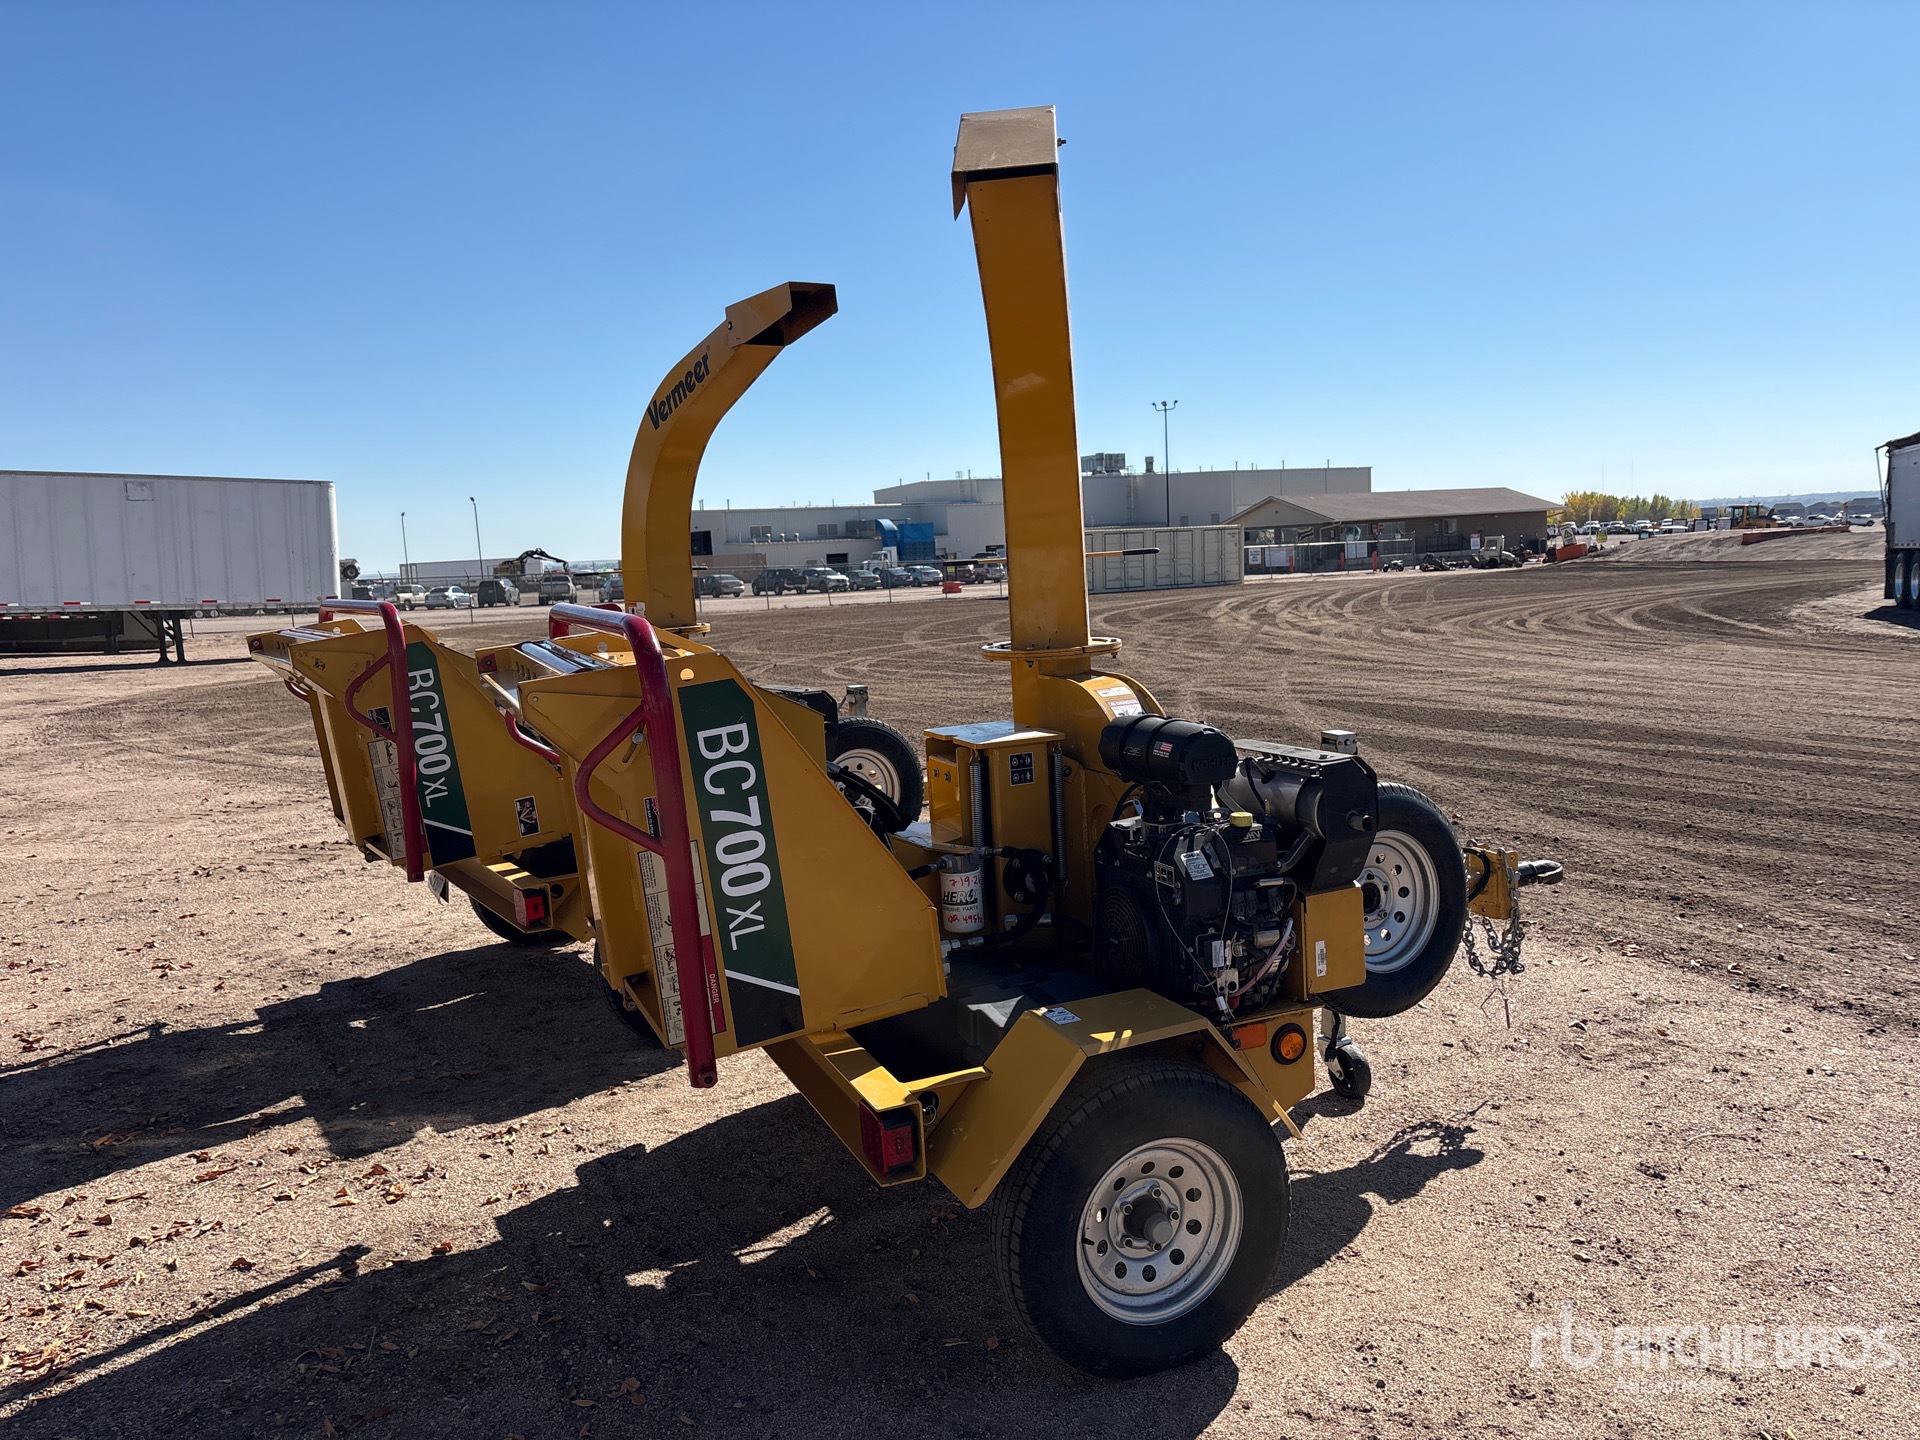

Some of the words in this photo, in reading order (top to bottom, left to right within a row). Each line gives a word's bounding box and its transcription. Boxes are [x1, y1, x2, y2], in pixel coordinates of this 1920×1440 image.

[646, 351, 711, 431] Vermeer
[1192, 756, 1233, 771] KOHLER
[709, 973, 720, 1004] DANGER
